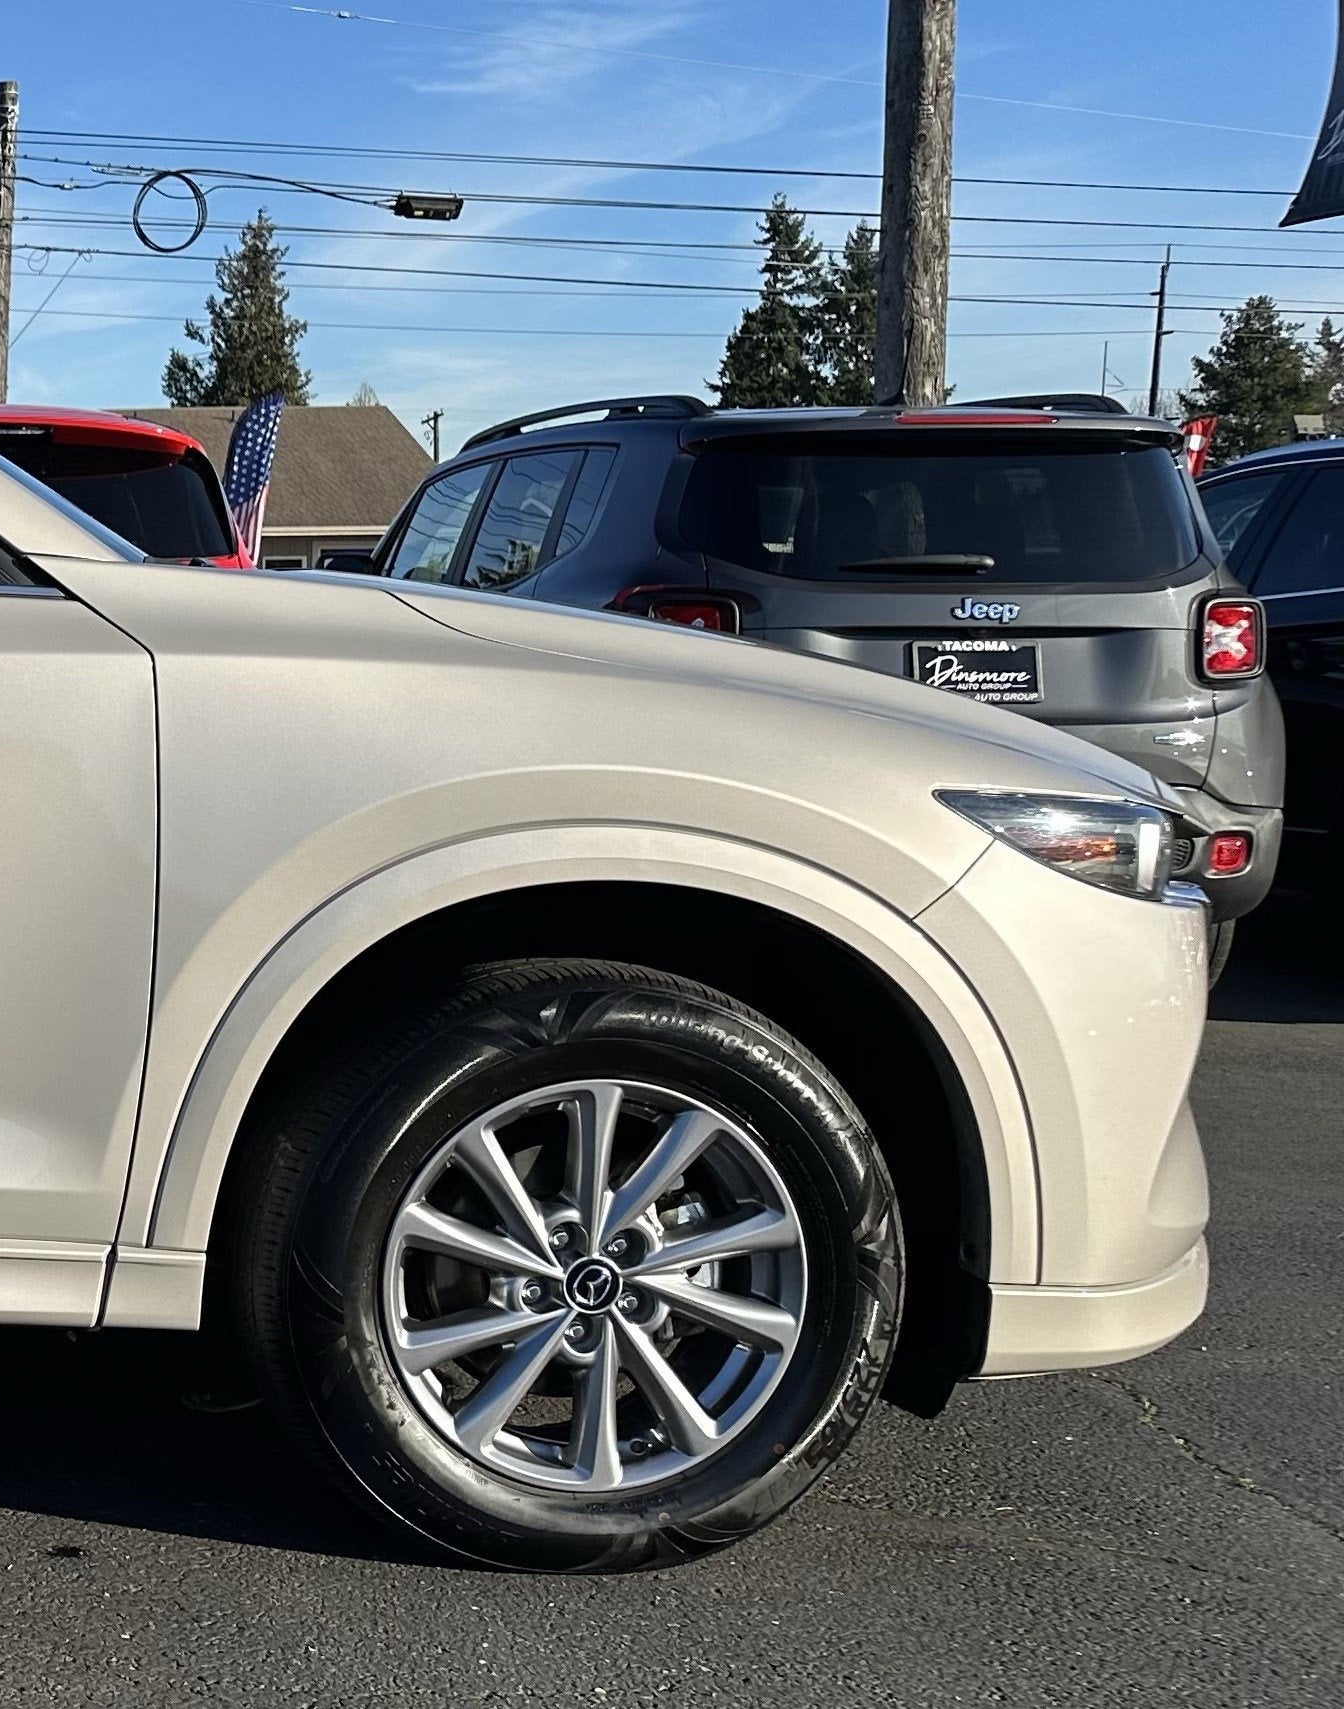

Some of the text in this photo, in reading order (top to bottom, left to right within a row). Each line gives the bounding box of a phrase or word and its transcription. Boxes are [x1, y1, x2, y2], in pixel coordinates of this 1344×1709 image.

[951, 597, 1020, 624] Jeep
[941, 641, 1010, 652] TACOMA
[925, 655, 1032, 687] Dinsmore
[957, 683, 1013, 691] AUTO GROUP
[974, 692, 1039, 702] AUTO GROUP
